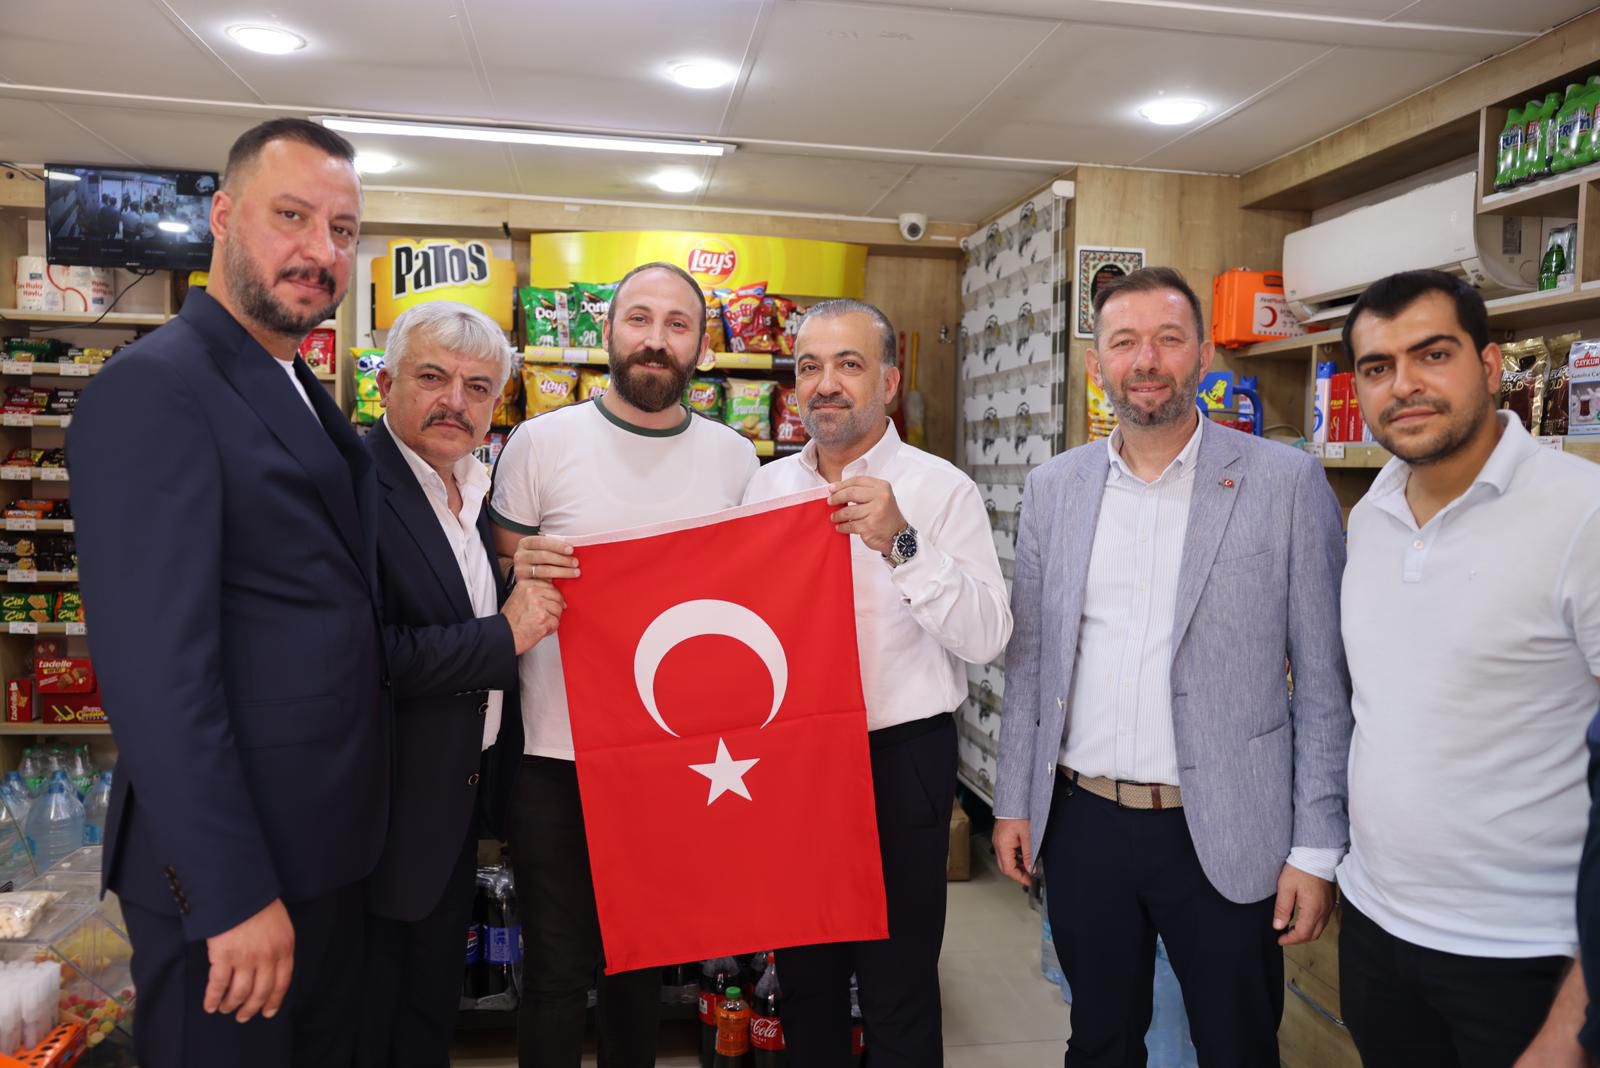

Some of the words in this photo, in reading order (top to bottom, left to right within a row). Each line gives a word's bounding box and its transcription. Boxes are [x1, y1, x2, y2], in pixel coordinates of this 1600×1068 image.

[690, 249, 736, 276] Lay's
[39, 660, 73, 668] tadelle
[752, 1017, 781, 1038] Cola
